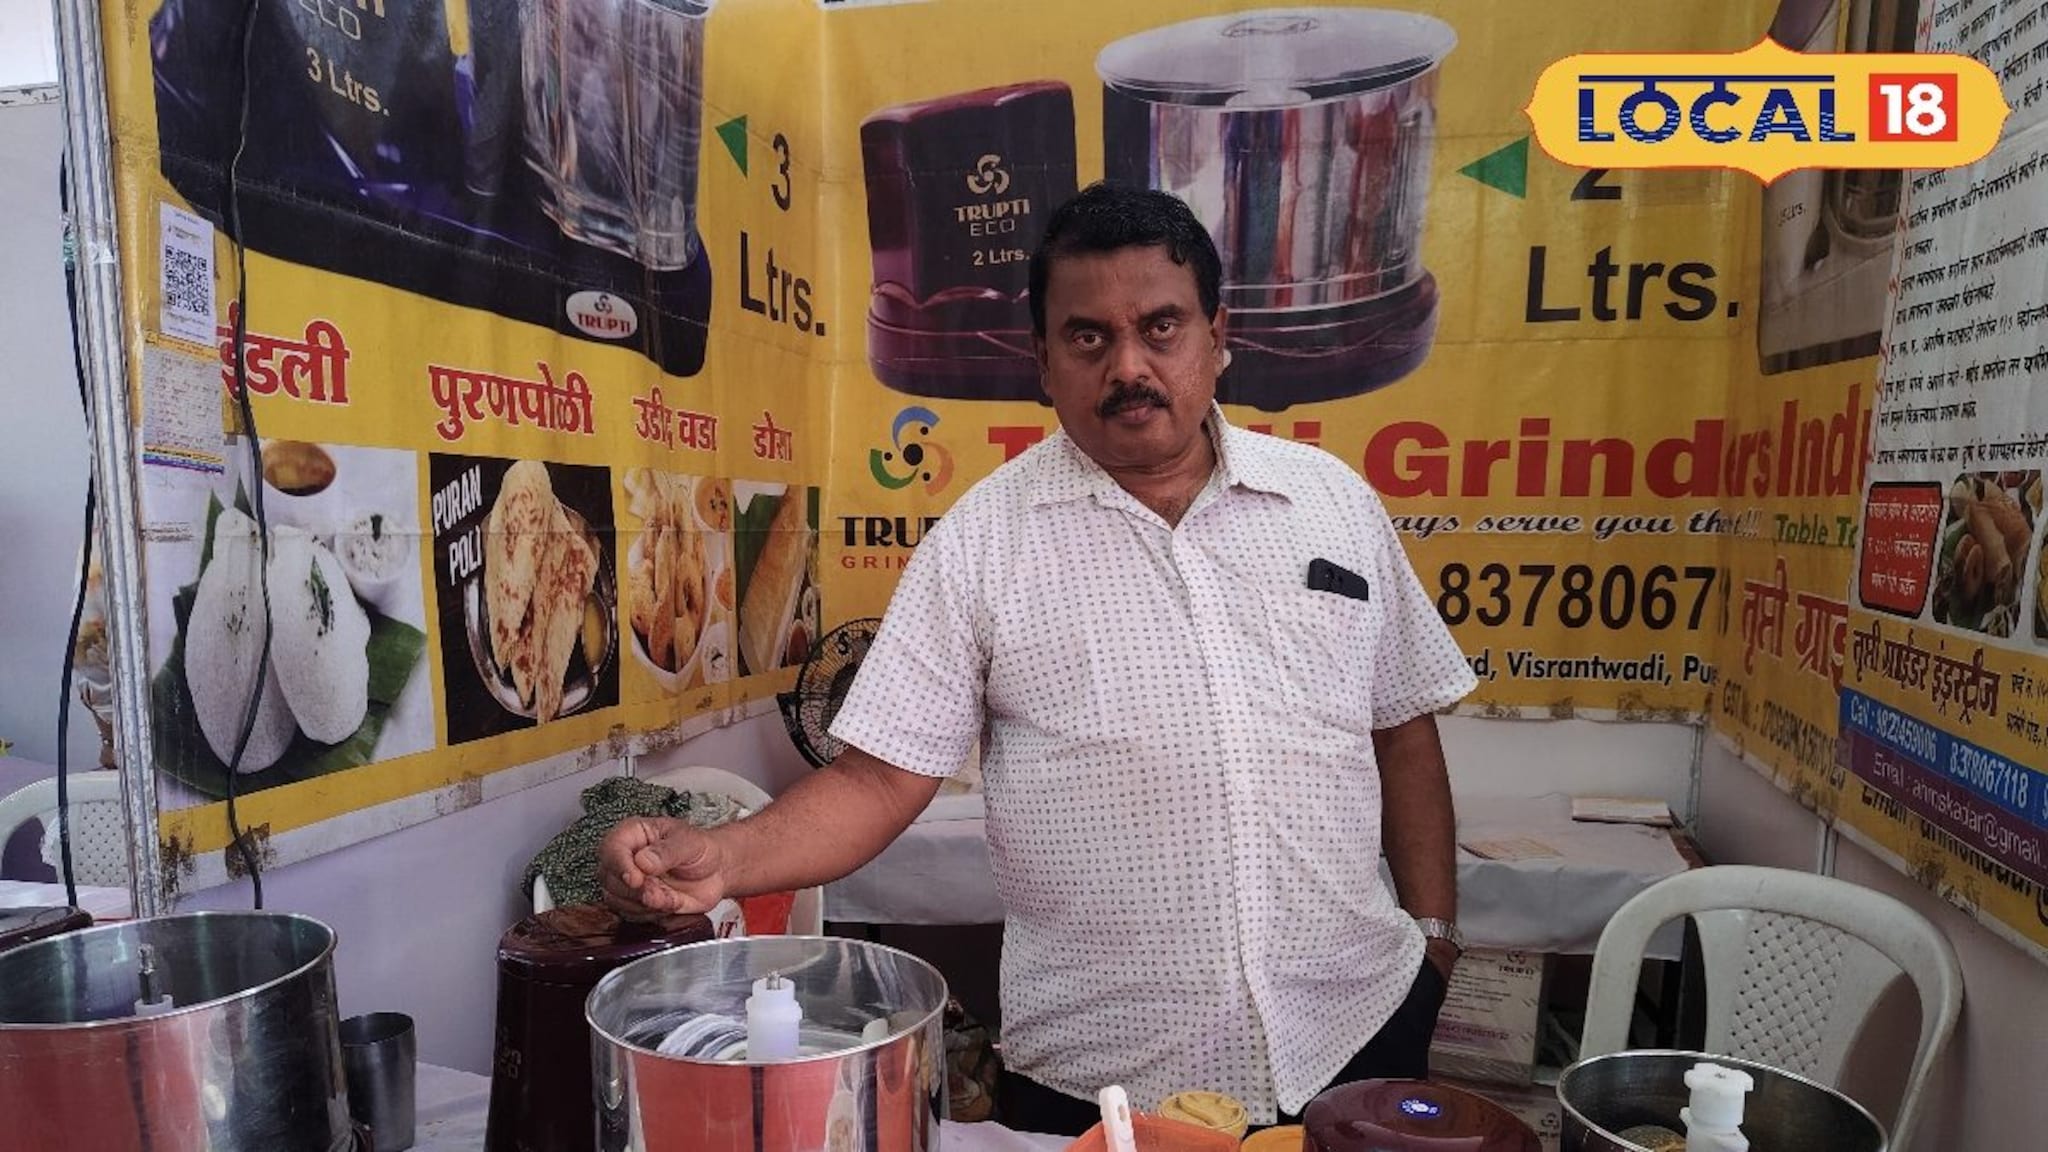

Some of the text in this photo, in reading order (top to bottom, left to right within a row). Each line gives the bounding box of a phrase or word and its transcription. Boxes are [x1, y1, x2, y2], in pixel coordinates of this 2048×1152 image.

[307, 47, 390, 117] 3 Ltrs.
[770, 132, 791, 212] 3
[954, 198, 1031, 223] TRUPTI
[970, 219, 1015, 237] ECO
[972, 247, 1031, 266] 2 Ltrs.
[740, 231, 825, 336] Ltrs.
[1525, 246, 1738, 322] Ltrs.
[576, 312, 631, 333] TRUPTI
[428, 362, 594, 441] पुरणपोळी
[677, 410, 717, 451] वडा
[433, 464, 482, 537] PURAN
[1476, 515, 1582, 534] serve
[1595, 515, 1677, 538] you
[1775, 514, 1829, 545] Table
[449, 525, 482, 586] POLI
[1507, 652, 1673, 685] Visrantwadi,
